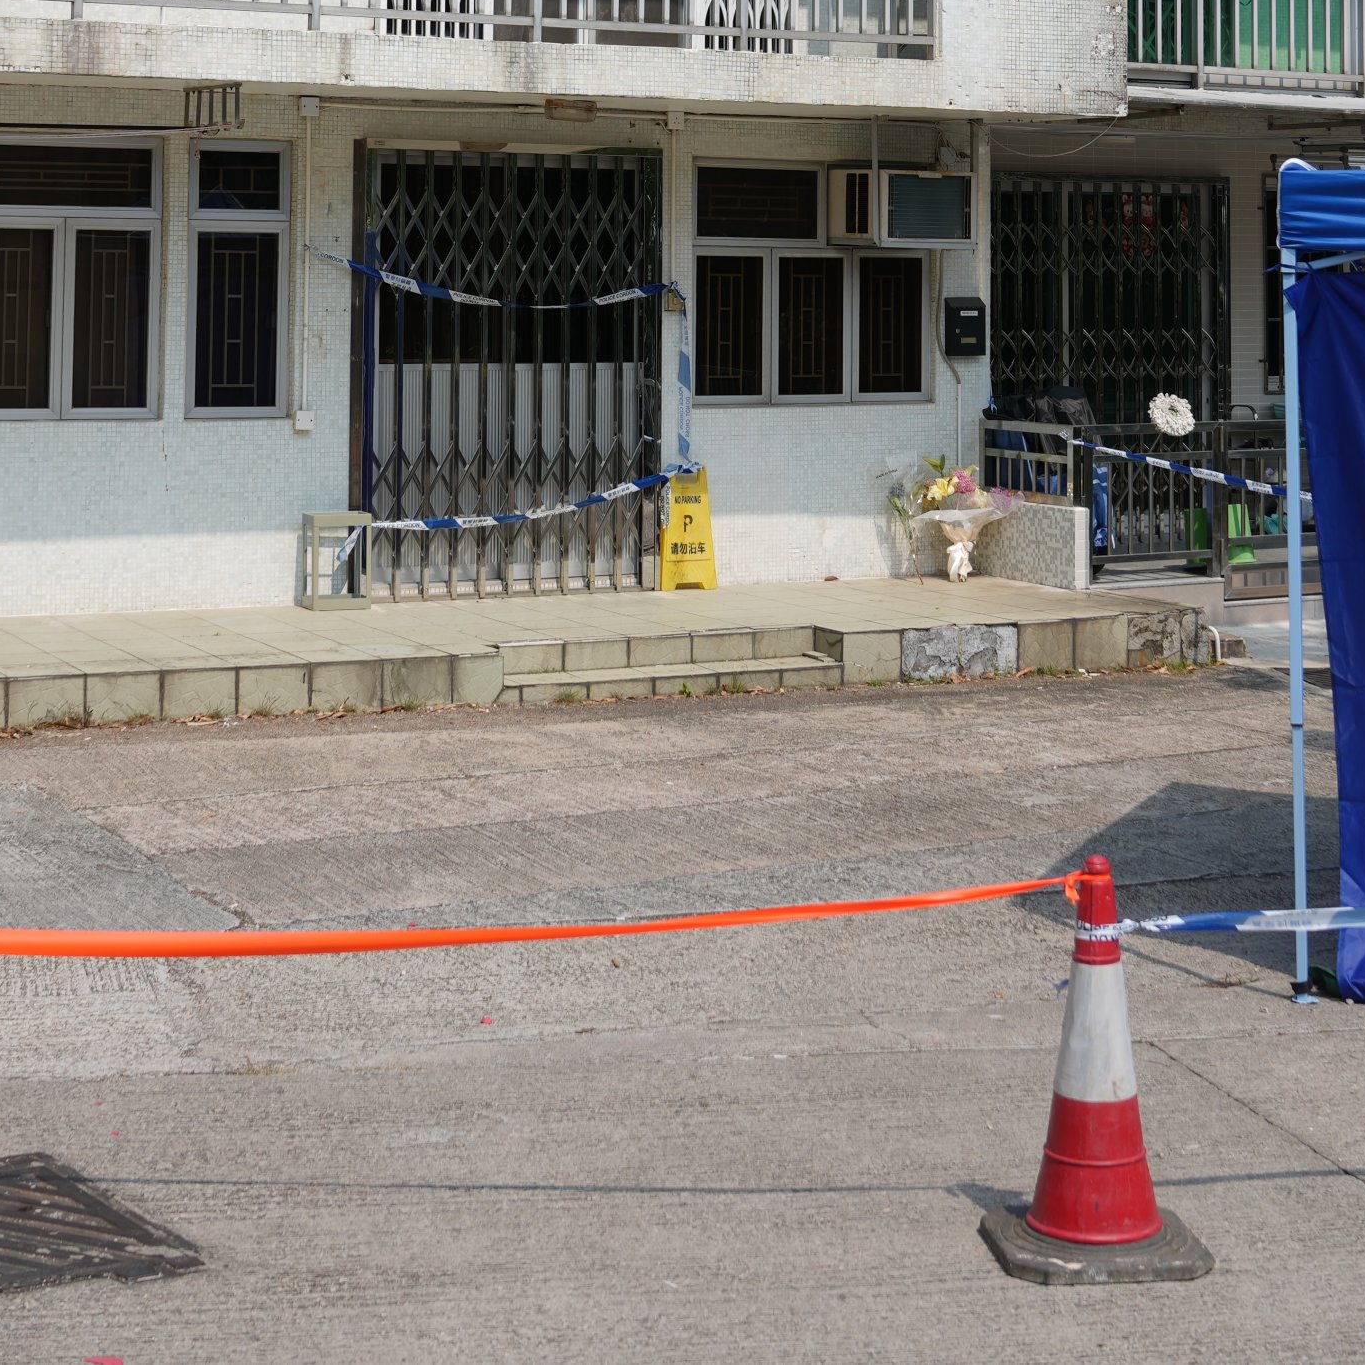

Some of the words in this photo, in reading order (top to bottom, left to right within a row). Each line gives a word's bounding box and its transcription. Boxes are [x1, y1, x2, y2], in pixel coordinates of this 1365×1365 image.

[674, 495, 681, 504] NO
[681, 495, 702, 504] PARKING
[670, 542, 706, 555] 请勿泊车
